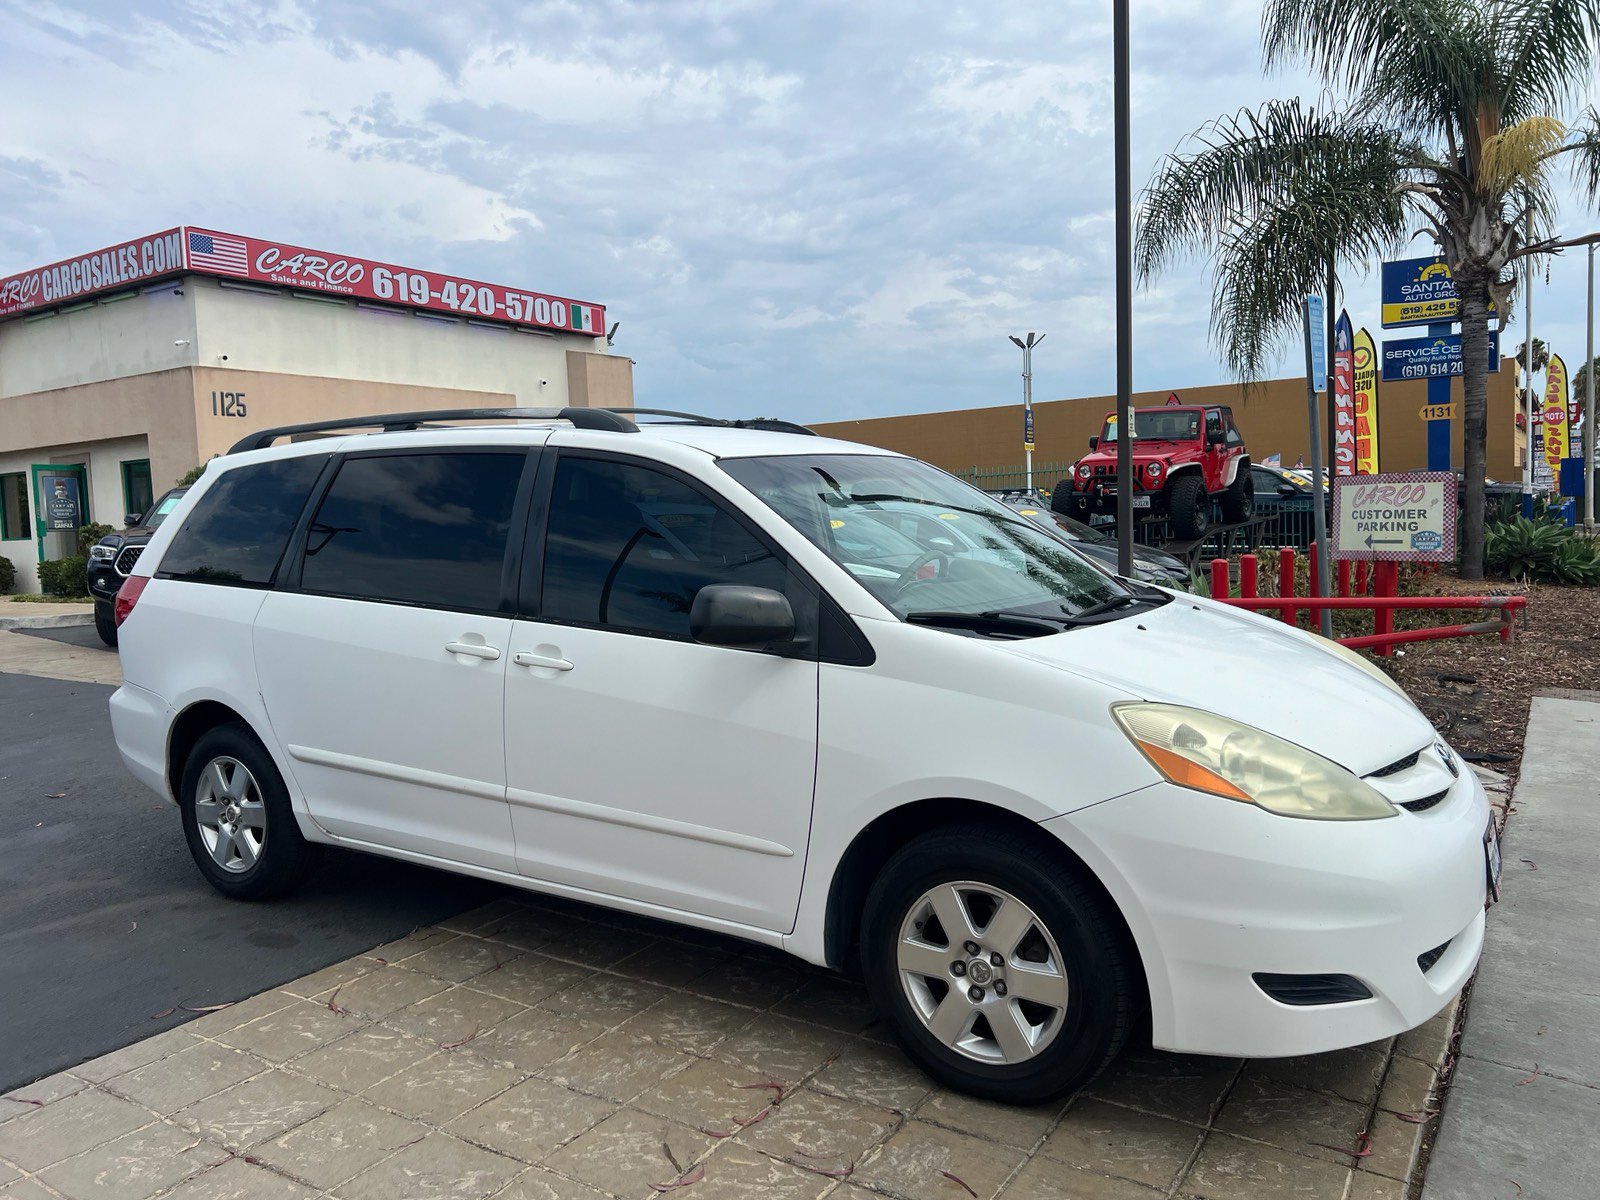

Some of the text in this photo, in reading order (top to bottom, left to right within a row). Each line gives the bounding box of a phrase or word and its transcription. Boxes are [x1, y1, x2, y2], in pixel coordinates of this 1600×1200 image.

[41, 232, 182, 301] CARCOSALES.COM
[255, 247, 365, 285] CARCO
[0, 273, 40, 305] ARCO
[271, 273, 353, 293] Sales and Finance
[1401, 280, 1457, 295] SANTA
[371, 267, 567, 328] 619-420-5700
[1404, 292, 1432, 301] AUTO
[1400, 305, 1423, 315] (619)
[1425, 303, 1446, 311] 426
[1386, 346, 1440, 359] SERVICE
[1402, 361, 1463, 377] (619) 614 20
[212, 391, 247, 417] 1125
[1422, 406, 1450, 419] 1131
[1352, 484, 1426, 508] CARCO
[1351, 509, 1427, 520] CUSTOMER
[1357, 521, 1418, 532] PARKING
